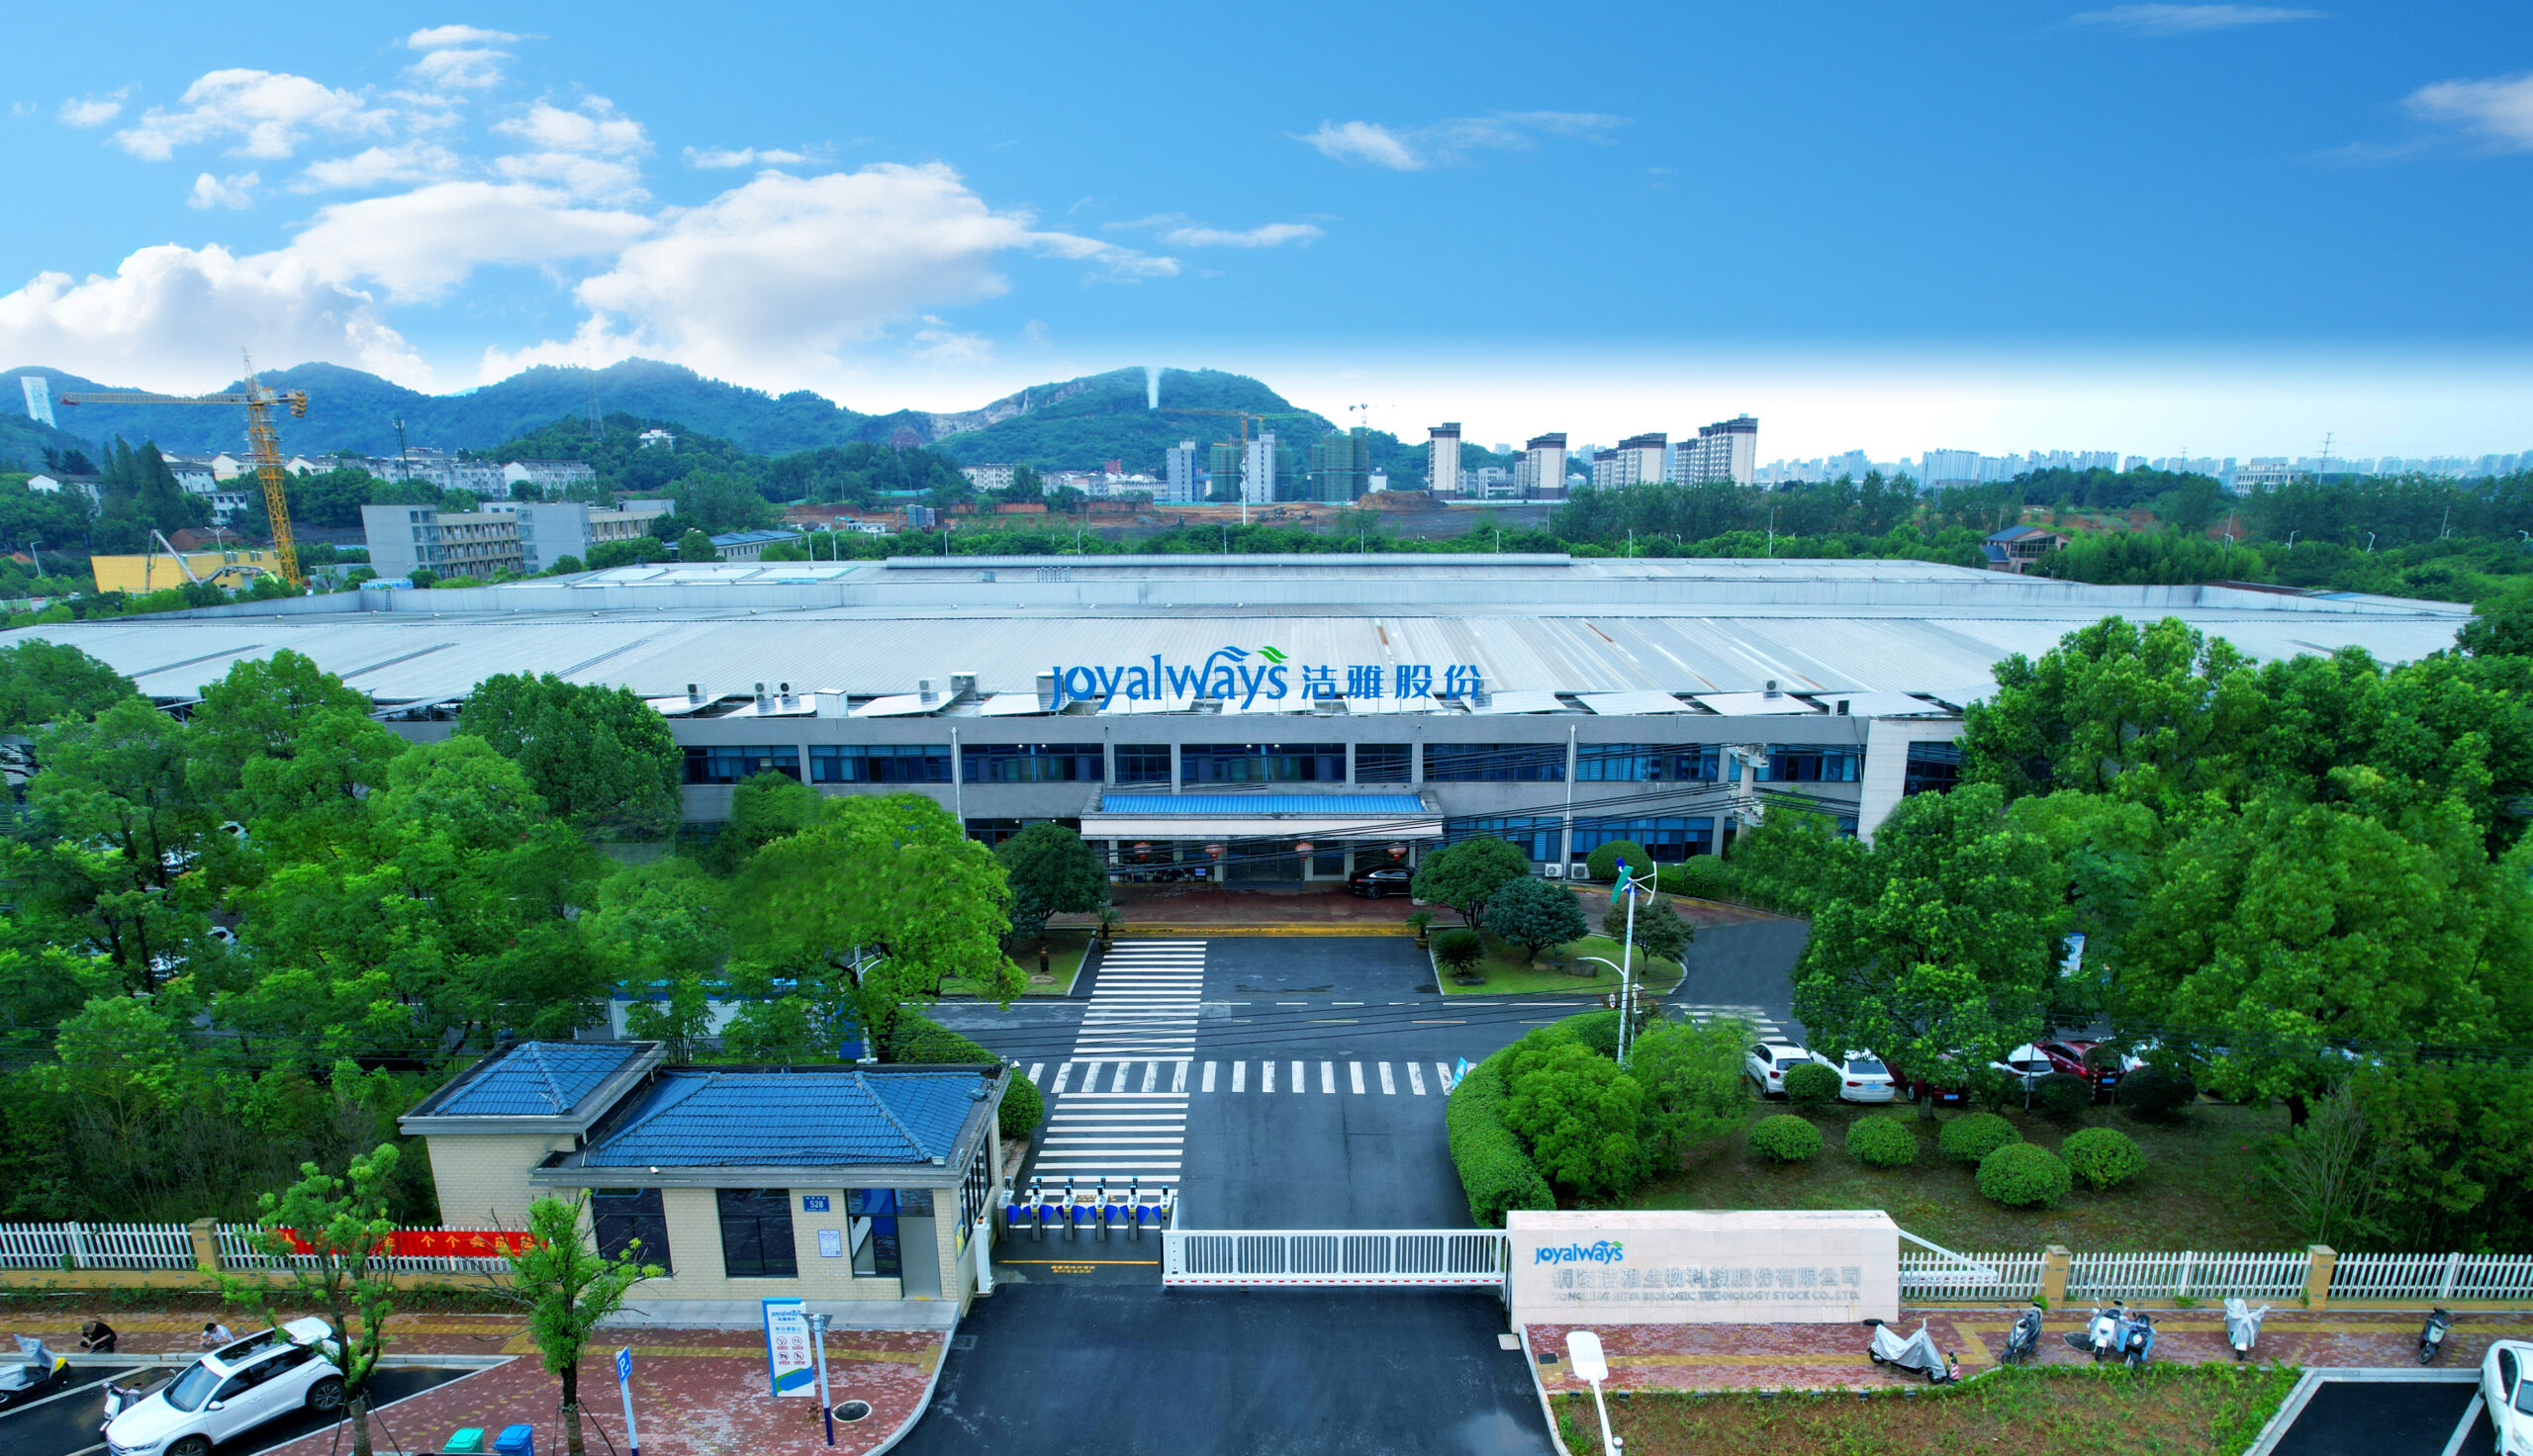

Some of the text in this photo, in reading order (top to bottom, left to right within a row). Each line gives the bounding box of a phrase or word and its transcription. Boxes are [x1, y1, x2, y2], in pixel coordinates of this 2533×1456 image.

[1301, 665, 1482, 700] 洁雅股份
[809, 1200, 824, 1209] 528
[1773, 1290, 1810, 1301] STOCK
[619, 1357, 626, 1377] P
